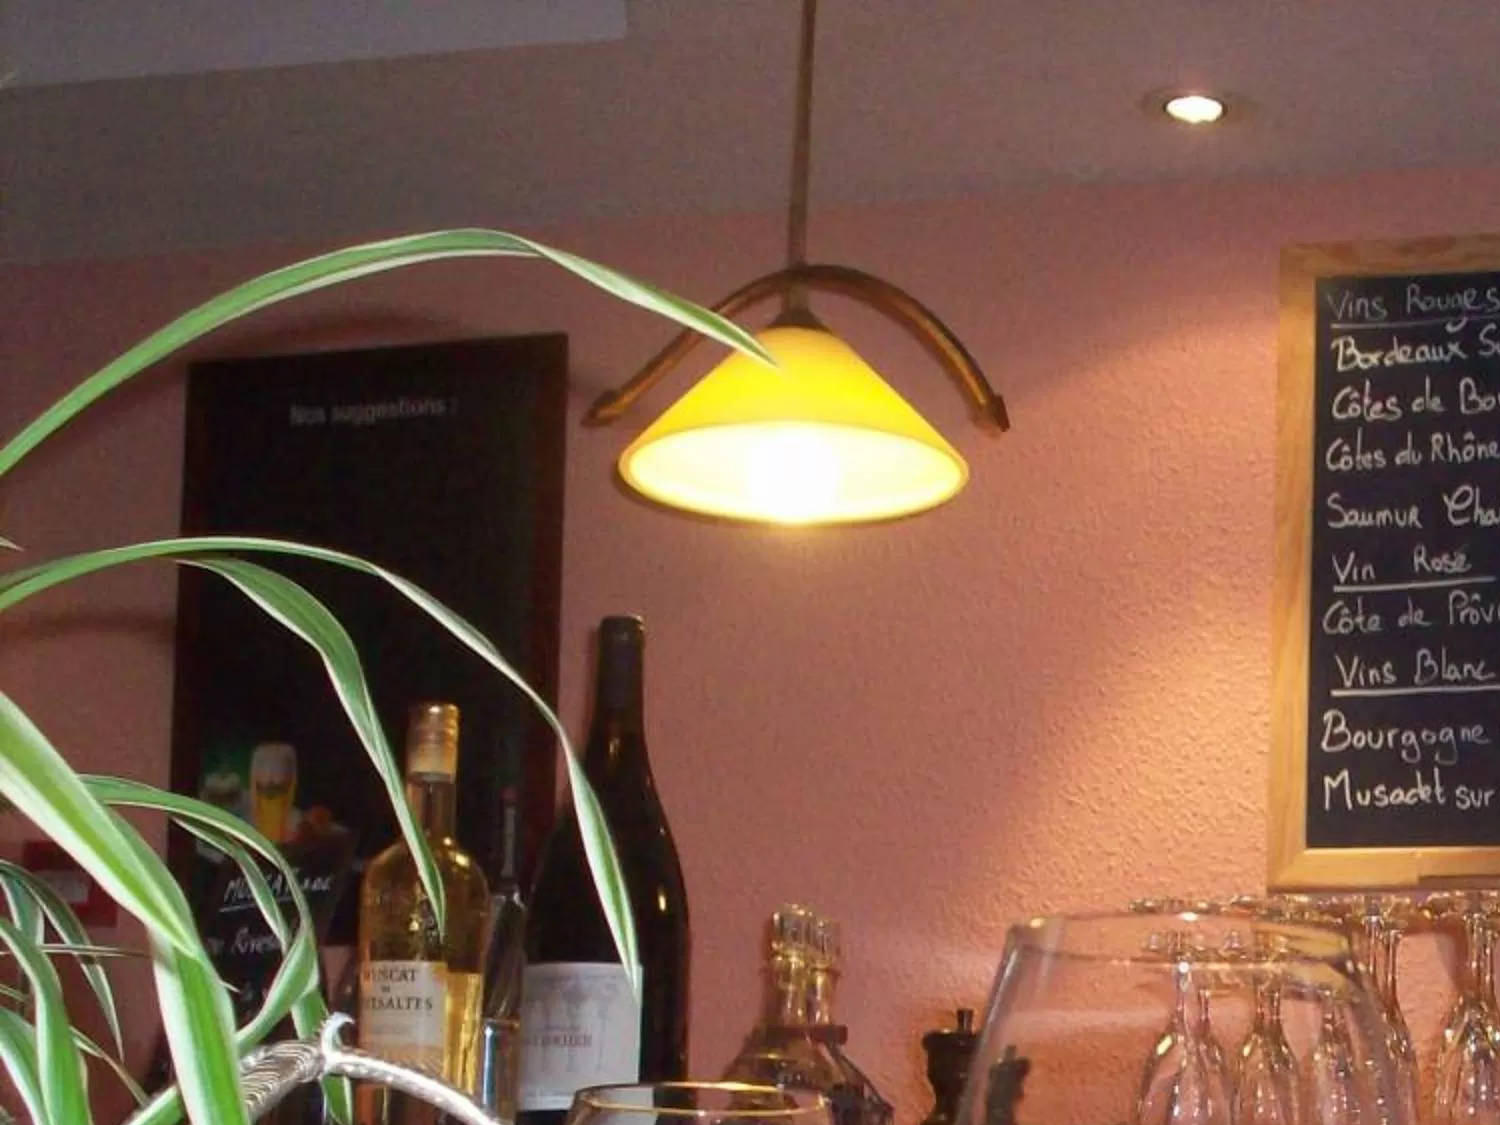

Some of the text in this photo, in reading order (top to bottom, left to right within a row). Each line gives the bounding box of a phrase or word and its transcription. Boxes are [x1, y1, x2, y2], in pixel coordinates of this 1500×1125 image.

[1327, 290, 1388, 322] Vins
[1331, 334, 1468, 373] Bordeaux
[1332, 377, 1403, 423] Côtes
[1411, 373, 1446, 414] de
[1325, 425, 1387, 472] Côtes
[1395, 436, 1423, 466] du
[1431, 429, 1500, 464] Rhône
[1332, 550, 1376, 584] Vin
[1322, 600, 1384, 637] Côte
[1396, 599, 1433, 628] de
[1334, 650, 1498, 688] Vins Blanc
[1321, 708, 1493, 766] Bourgogne
[1454, 784, 1496, 811] sur
